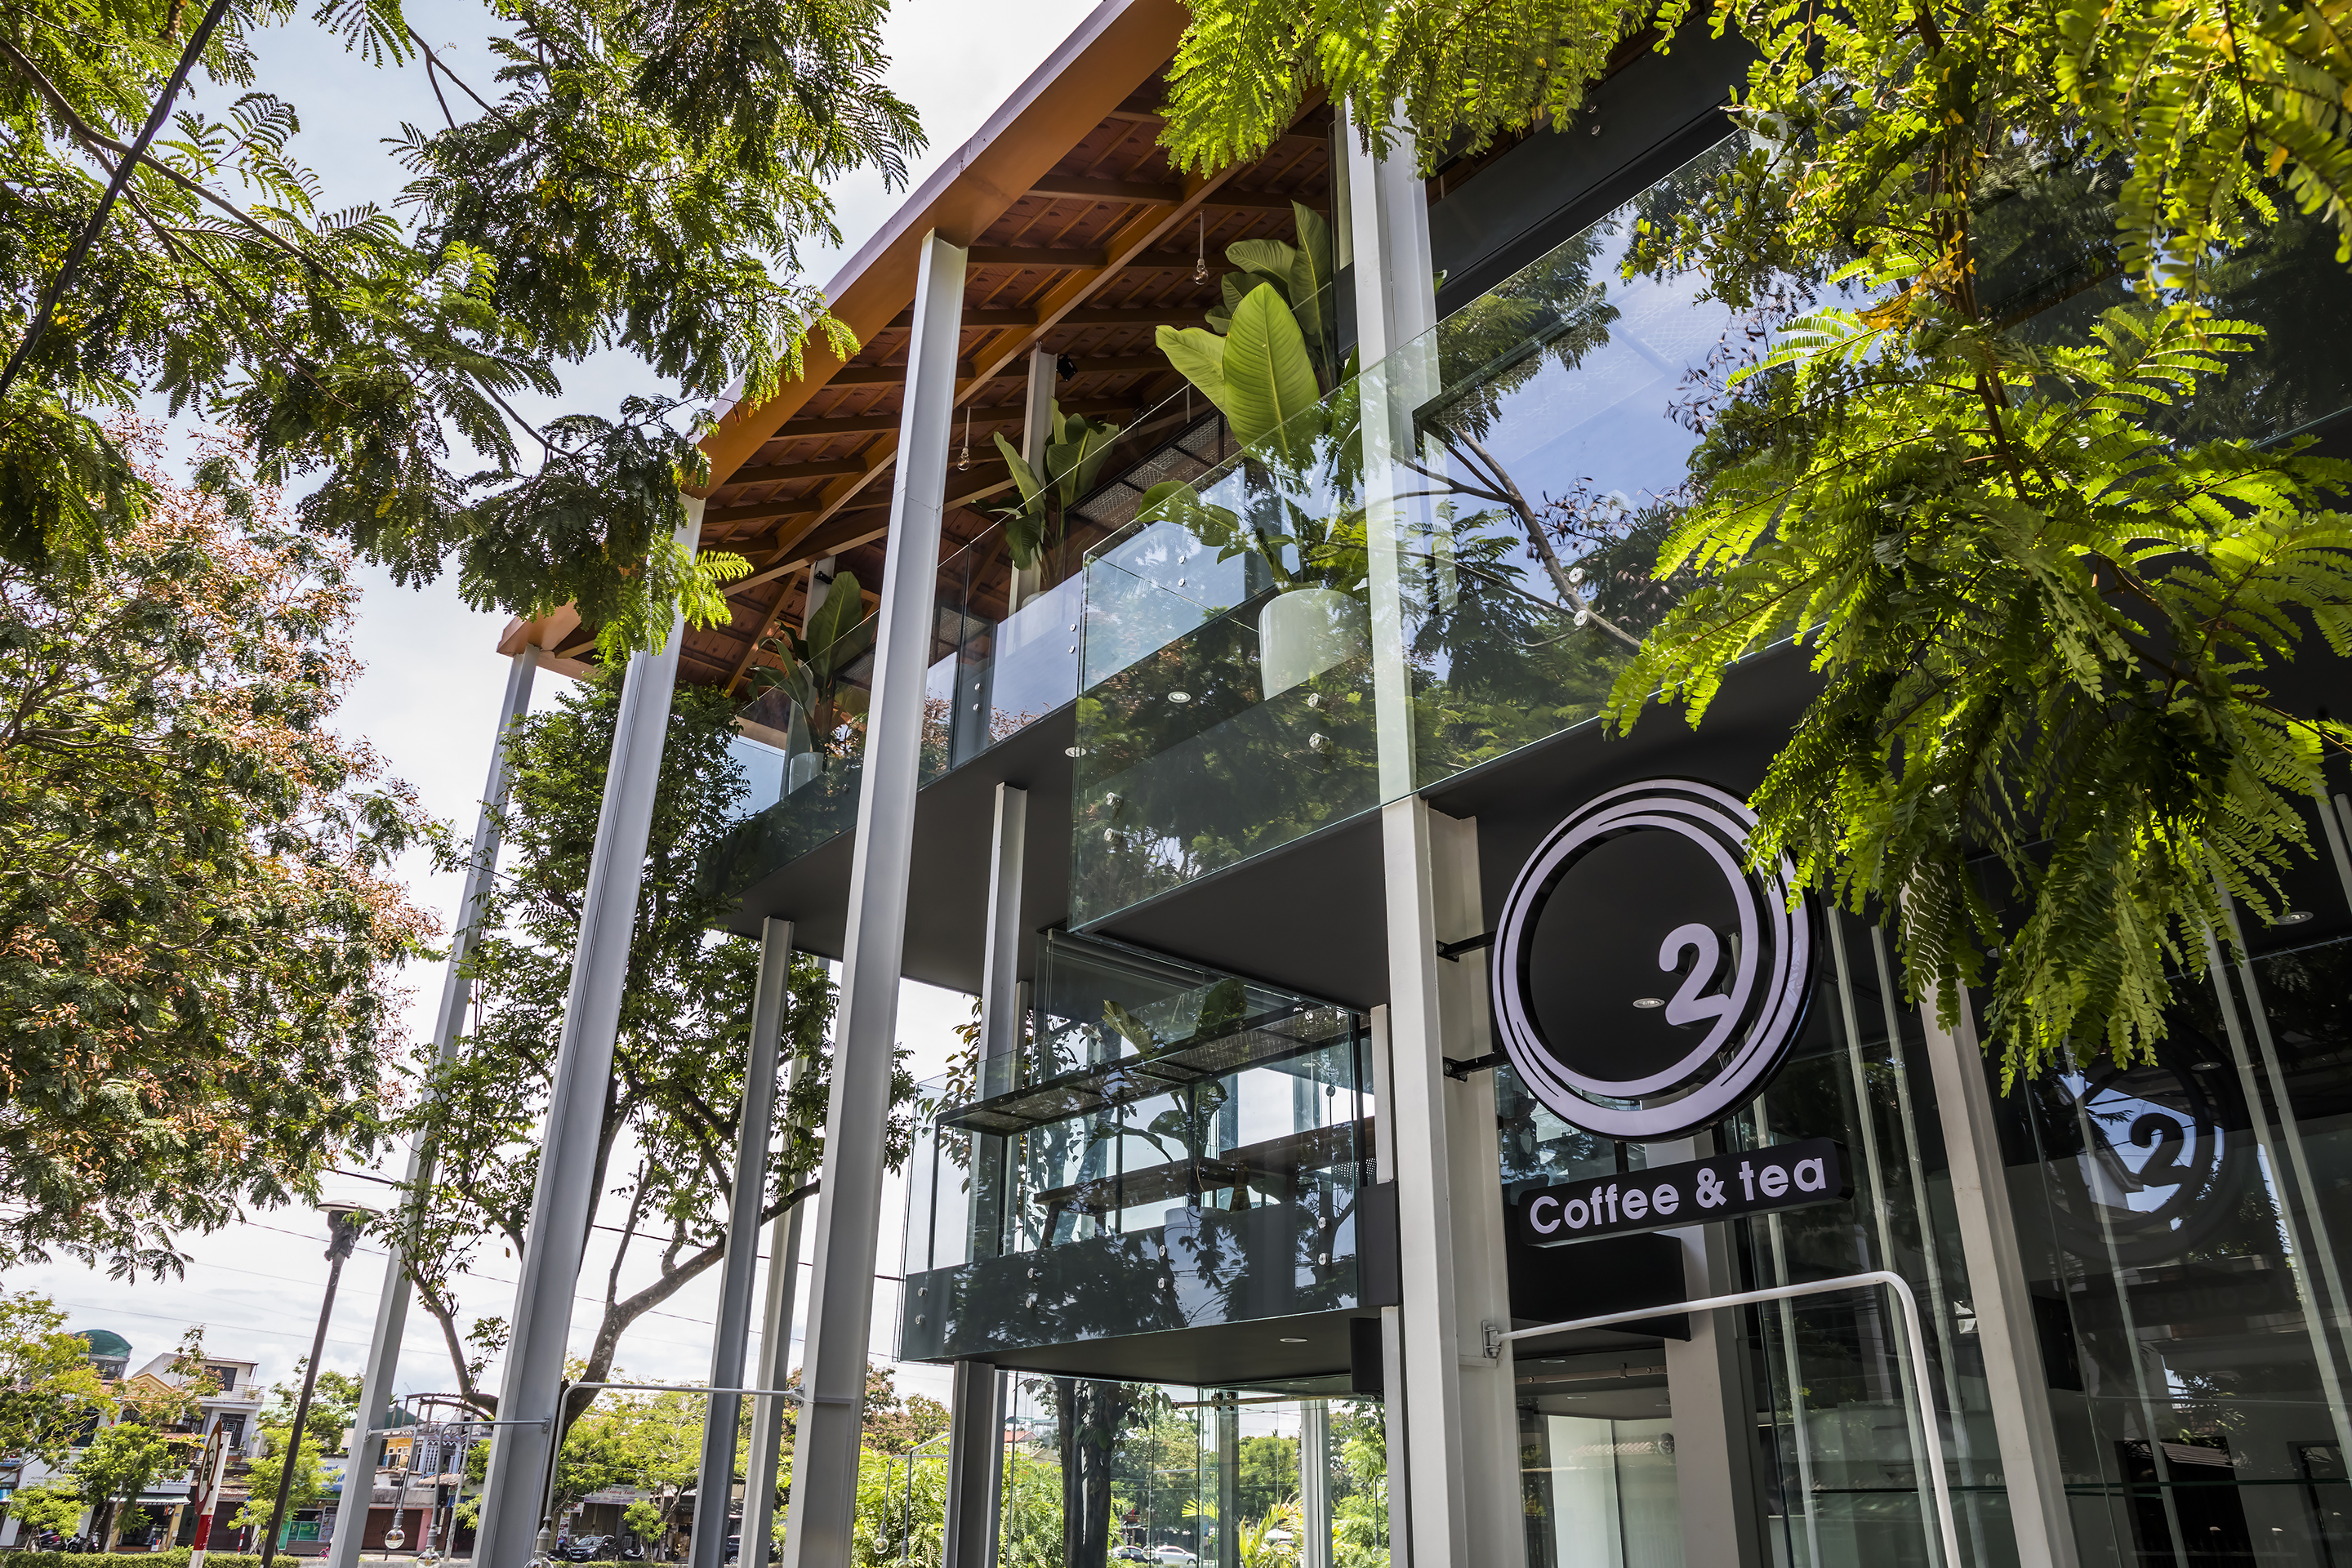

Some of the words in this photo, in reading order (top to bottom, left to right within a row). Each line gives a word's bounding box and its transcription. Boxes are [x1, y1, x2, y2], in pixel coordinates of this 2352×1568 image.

[1530, 1183, 1680, 1234] Coffee
[1695, 1168, 1727, 1209] &
[1739, 1158, 1827, 1200] tea
